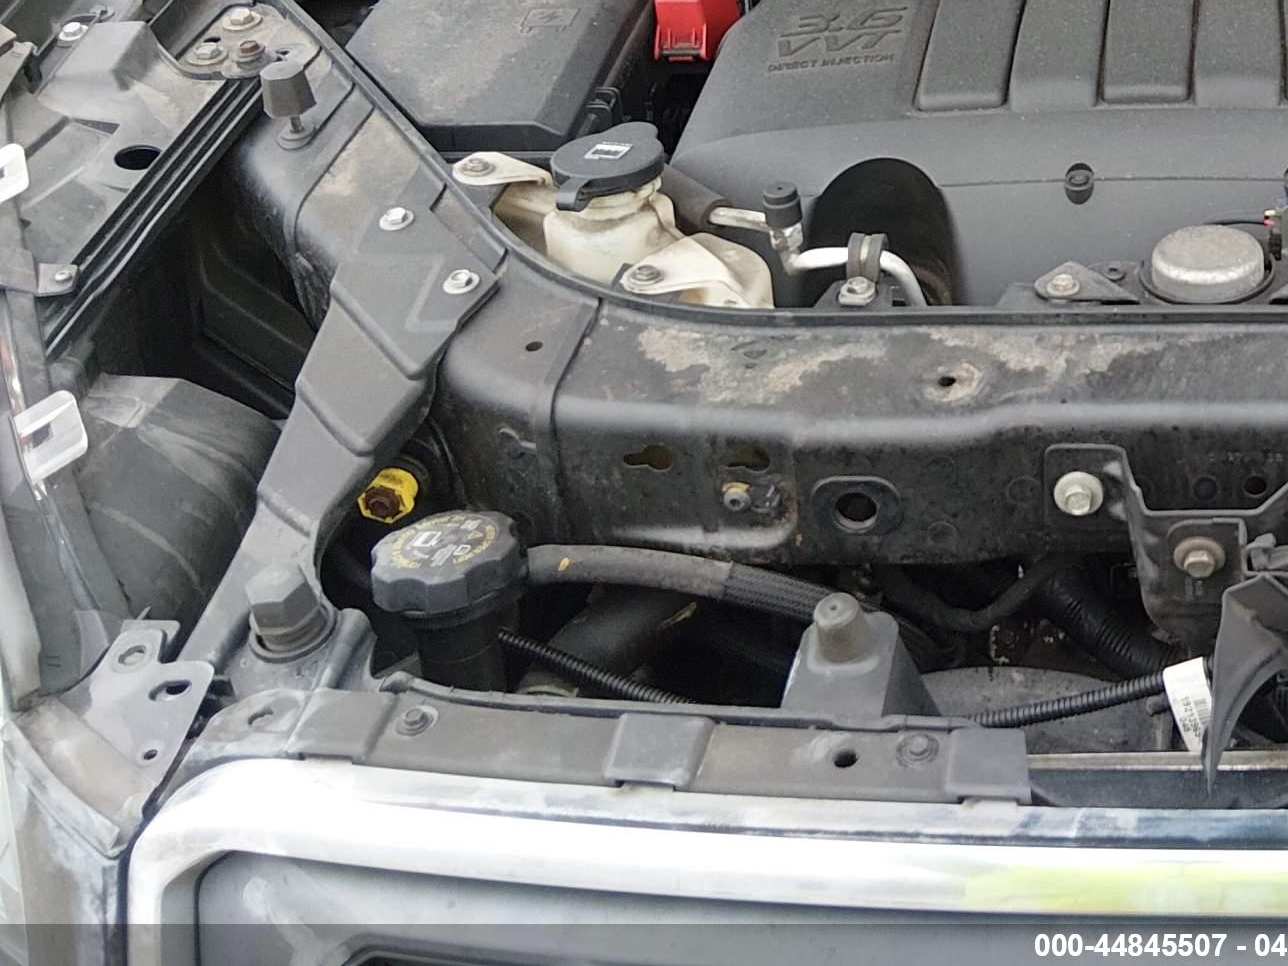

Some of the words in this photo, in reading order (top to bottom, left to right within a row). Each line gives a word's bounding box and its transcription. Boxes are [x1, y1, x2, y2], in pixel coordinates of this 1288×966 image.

[779, 6, 908, 37] 3.6
[778, 29, 902, 57] VVT
[767, 59, 818, 73] DIRECT
[820, 53, 895, 67] INJECTION
